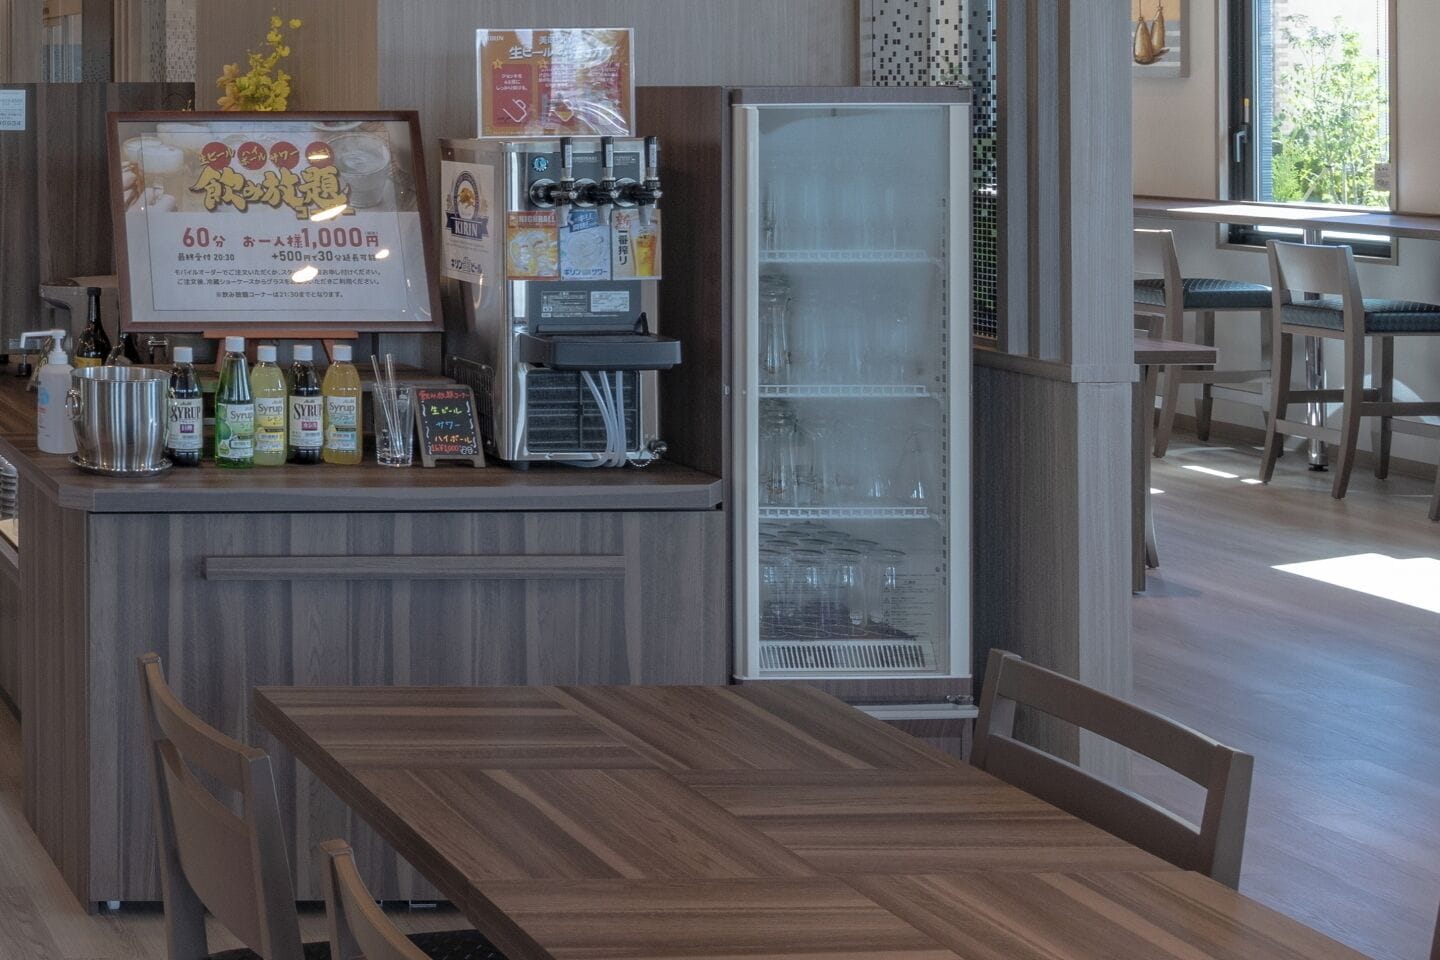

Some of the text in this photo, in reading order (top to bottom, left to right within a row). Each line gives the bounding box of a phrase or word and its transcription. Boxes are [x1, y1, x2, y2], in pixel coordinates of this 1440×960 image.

[270, 149, 300, 163] サワー
[189, 165, 351, 213] 飲み放題
[455, 220, 478, 237] KIRIN
[182, 227, 379, 250] 60分 お一人様1,000円
[617, 230, 629, 266] 一番搾り
[213, 253, 235, 262] 20:30
[257, 403, 283, 415] Syrup
[329, 402, 355, 415] Syrup
[430, 405, 463, 416] 生ビール
[435, 420, 461, 430] サワー
[434, 434, 473, 443] ハイボール
